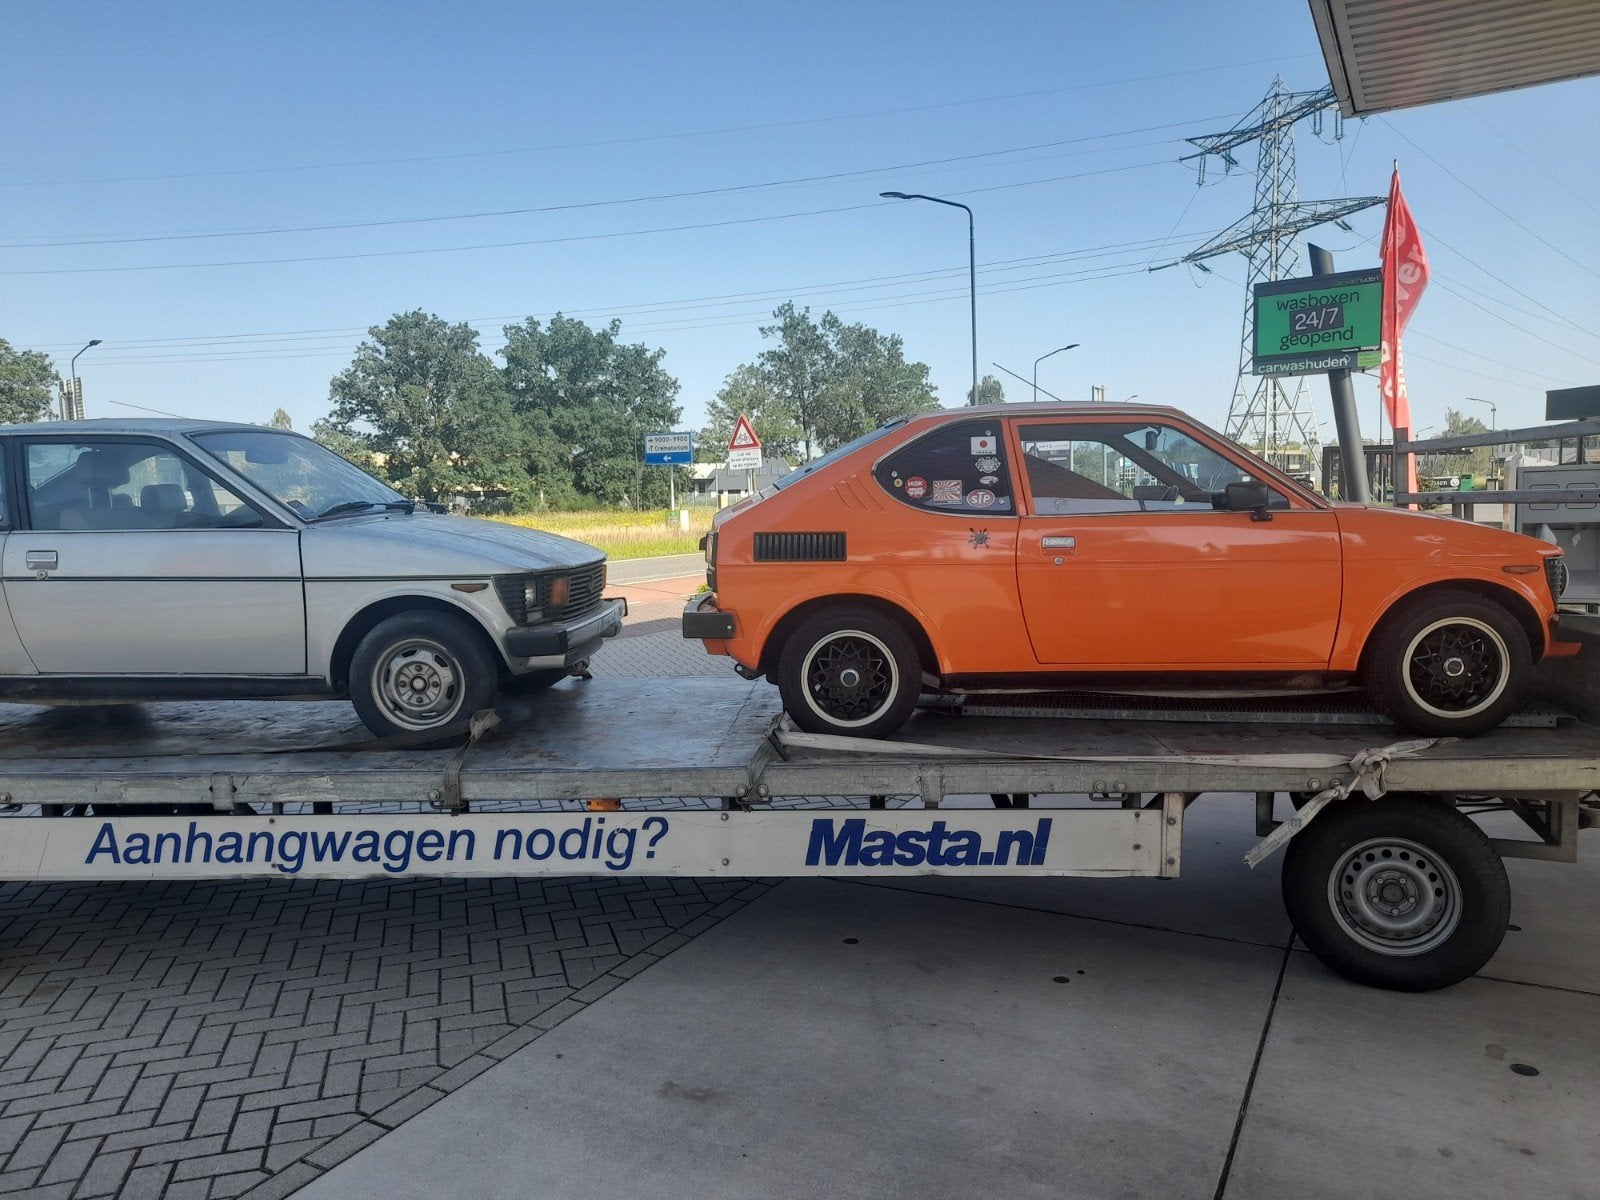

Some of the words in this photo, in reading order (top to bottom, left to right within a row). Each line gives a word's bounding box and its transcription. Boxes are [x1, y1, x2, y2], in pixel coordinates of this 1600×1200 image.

[1277, 291, 1360, 311] wasboxen
[1295, 307, 1339, 331] 24/7
[1280, 325, 1354, 350] geopend
[1258, 357, 1348, 374] carwashuden
[971, 491, 990, 504] STP
[85, 821, 476, 873] Aanhangwagen
[493, 816, 669, 871] nodig?
[804, 818, 1052, 867] Masta.nl
